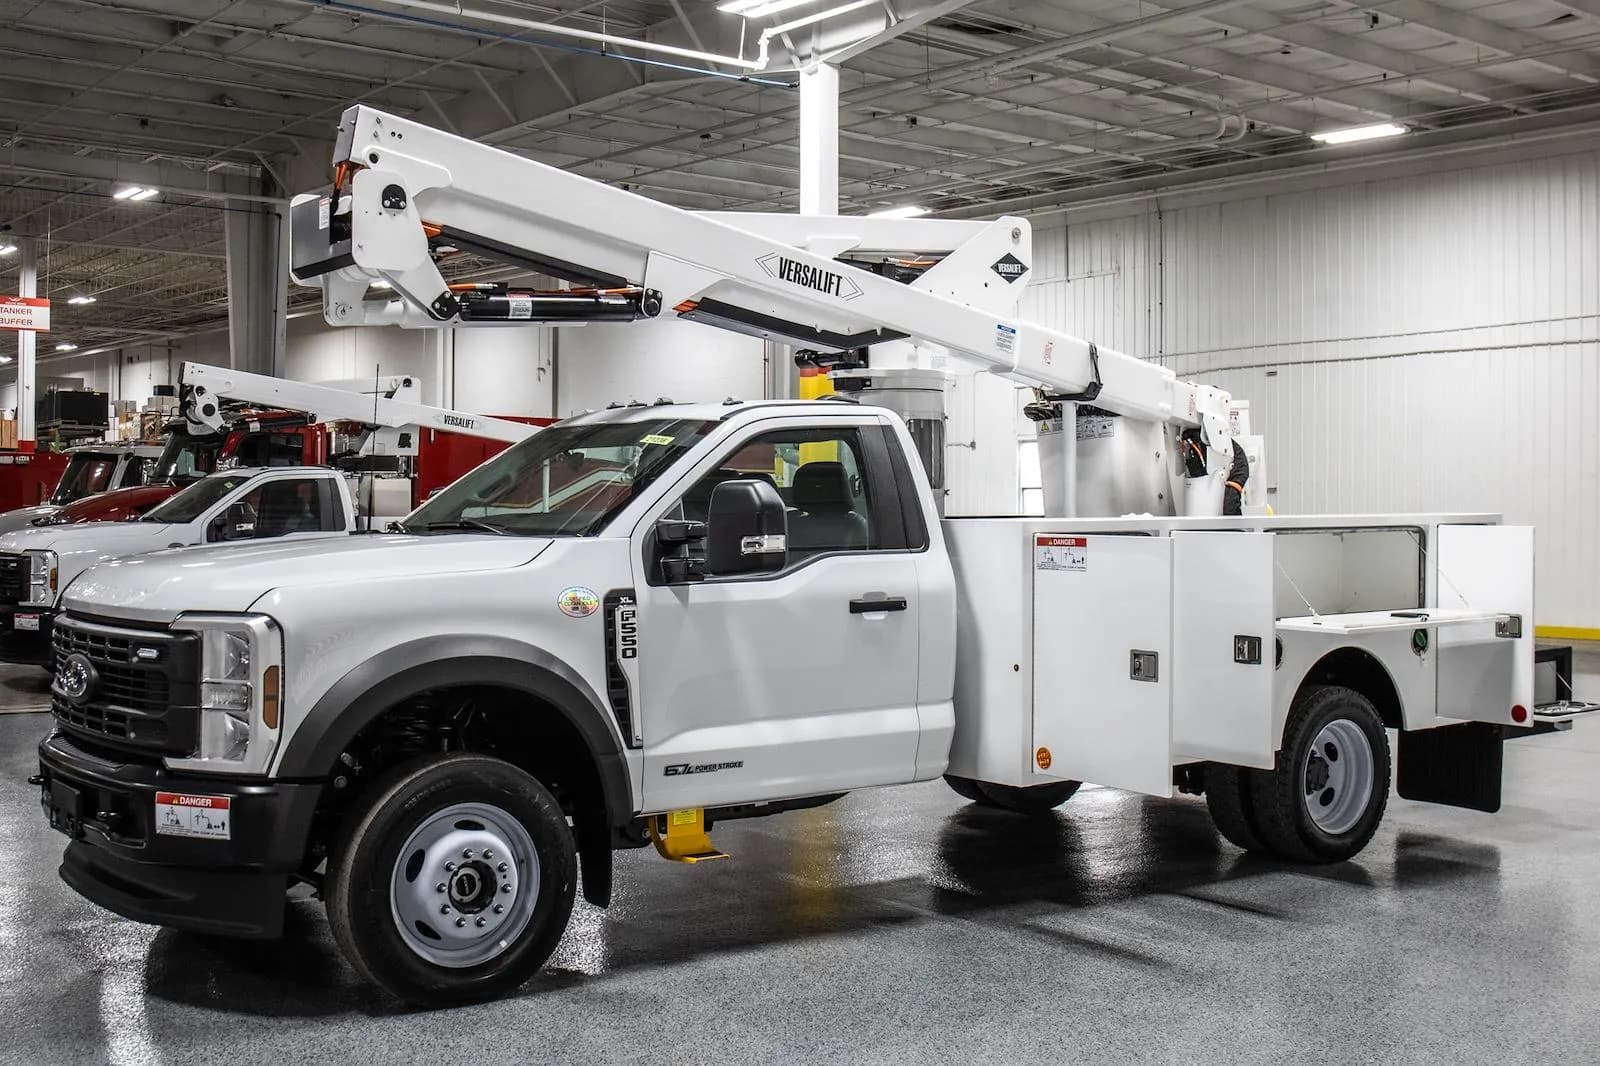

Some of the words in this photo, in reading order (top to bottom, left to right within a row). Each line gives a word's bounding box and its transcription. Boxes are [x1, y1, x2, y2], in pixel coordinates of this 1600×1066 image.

[779, 256, 843, 297] VERSALIFT
[0, 306, 33, 315] TANKER
[444, 414, 474, 429] VERSALIFT
[1053, 538, 1076, 546] DANGER
[620, 596, 634, 604] XL
[663, 764, 694, 776] 6.7L
[695, 764, 718, 774] POWER
[718, 761, 744, 770] STROKE
[179, 796, 212, 807] DANGER
